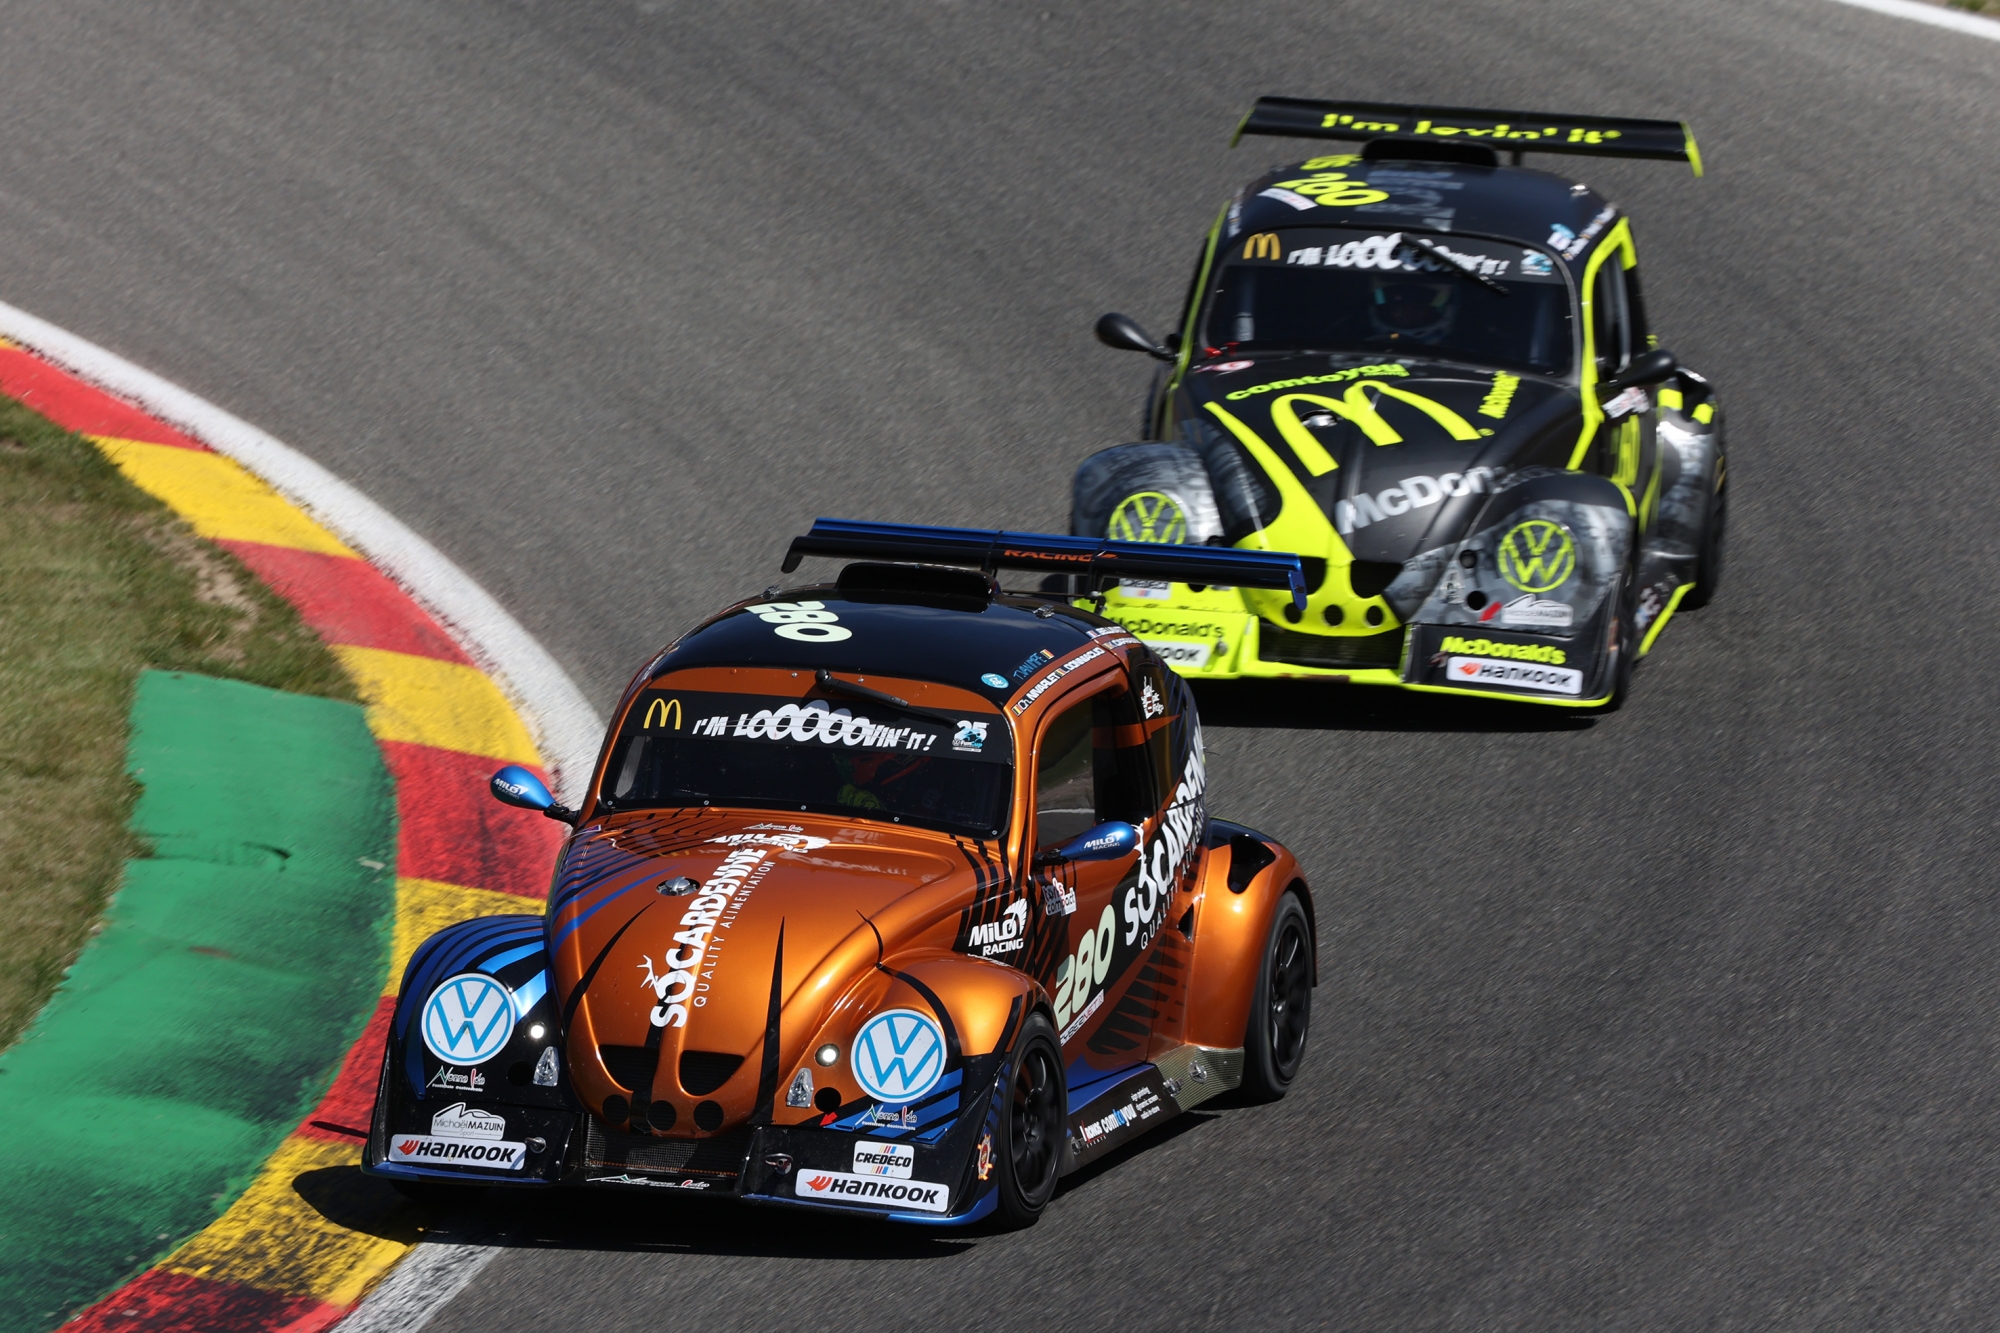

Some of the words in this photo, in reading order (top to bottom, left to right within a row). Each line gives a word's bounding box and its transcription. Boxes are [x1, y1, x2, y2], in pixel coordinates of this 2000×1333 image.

[744, 600, 853, 643] 280
[1440, 636, 1566, 665] McDonald's
[692, 716, 729, 737] I'M
[650, 848, 767, 1028] SOCARDENNE
[693, 935, 725, 1007] QUALITY
[720, 860, 776, 929] ALIMENTATION
[983, 938, 1024, 956] RACING
[1053, 904, 1116, 1031] 280
[1101, 1103, 1137, 1133] comtoyou
[855, 1152, 912, 1168] CREDECO
